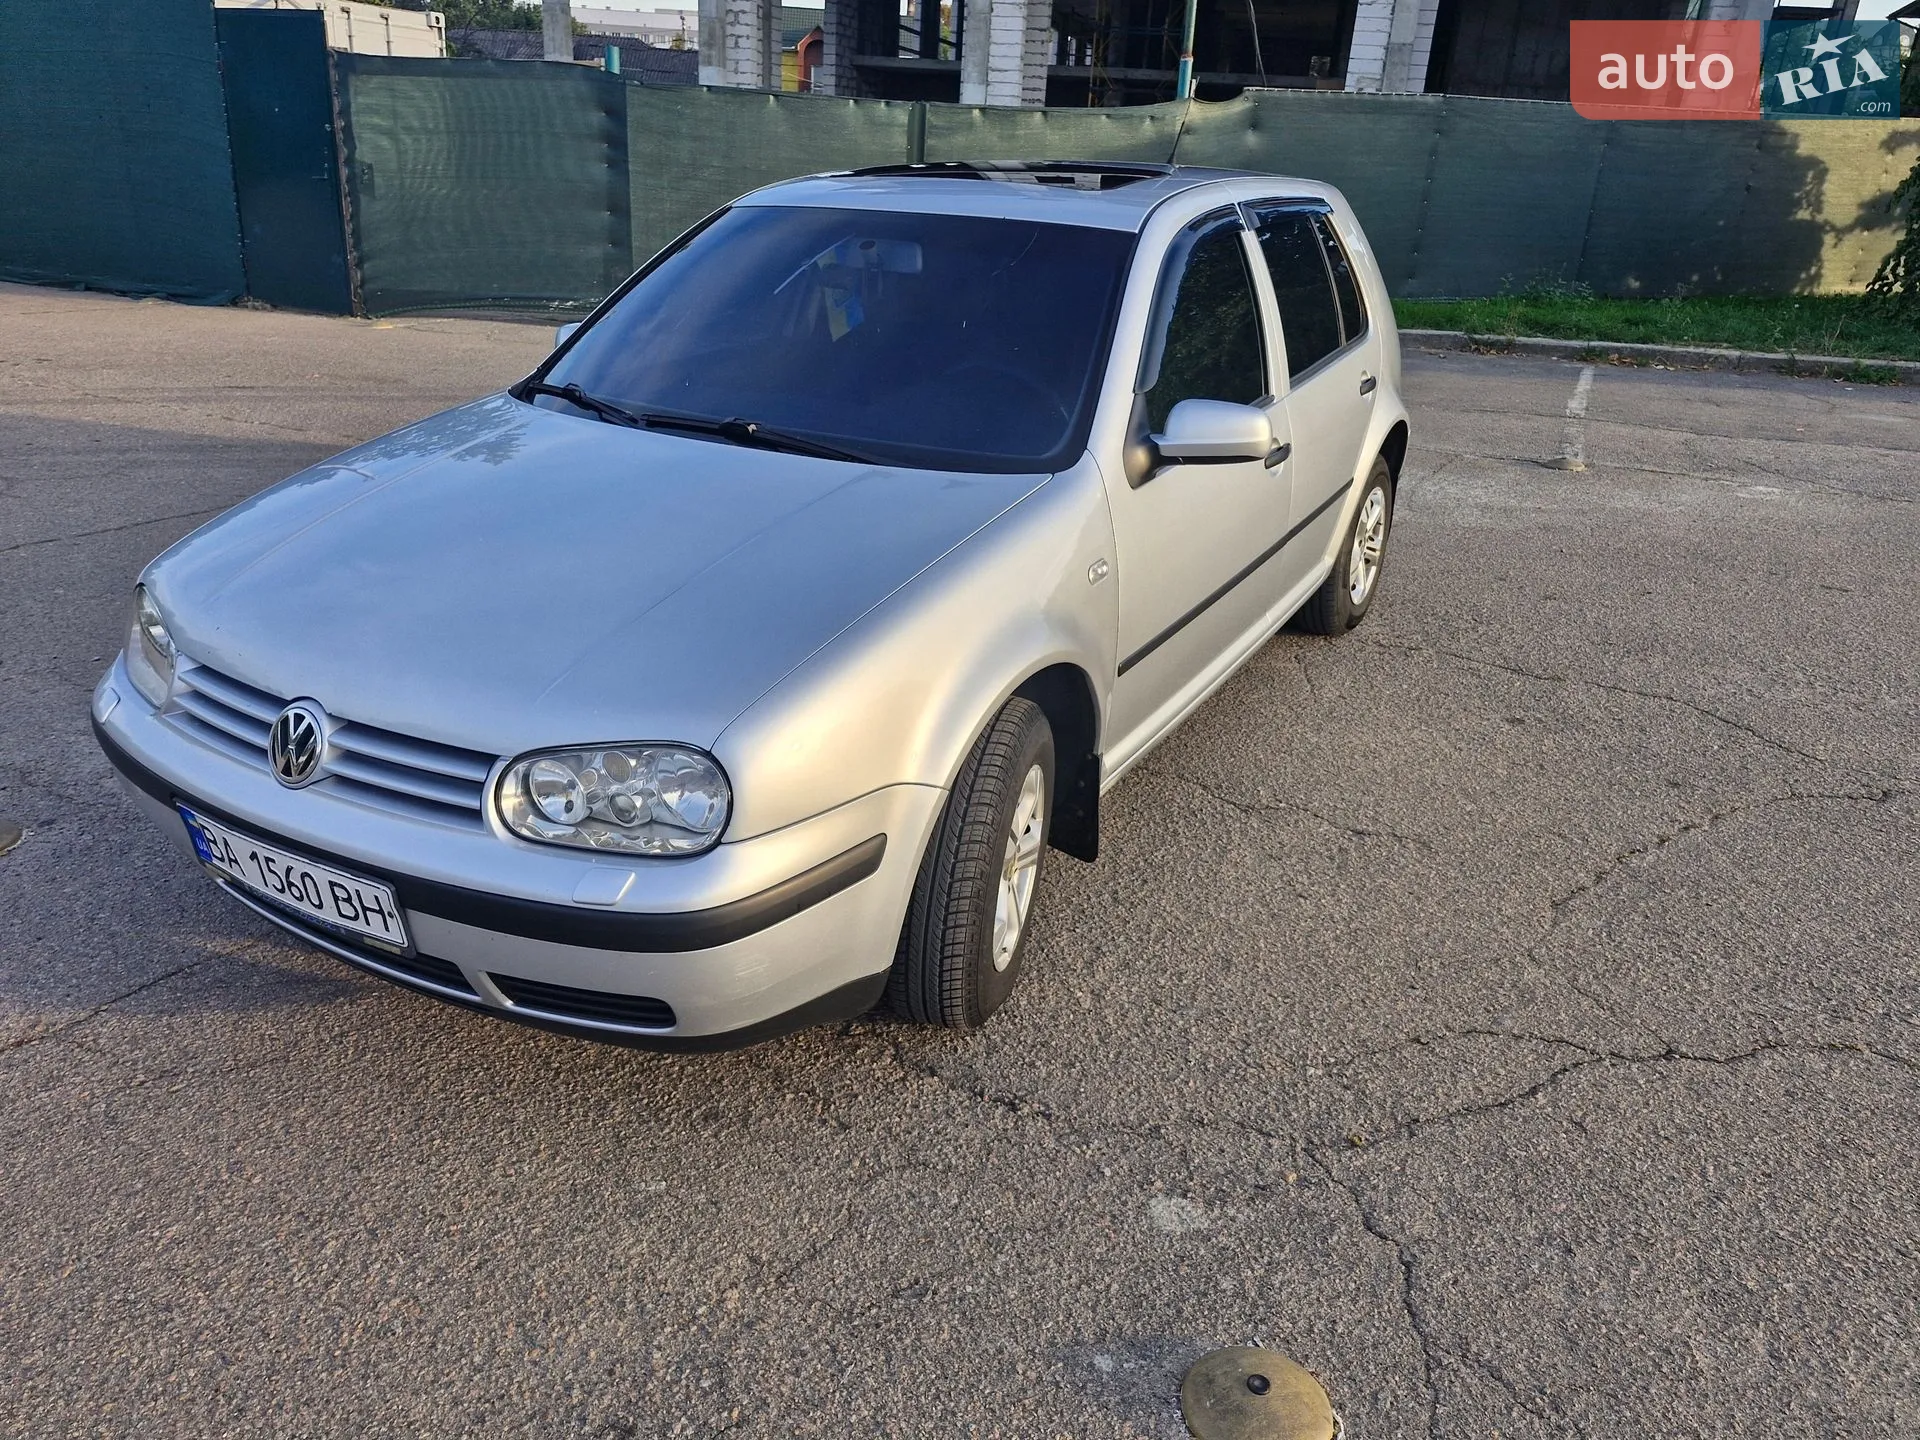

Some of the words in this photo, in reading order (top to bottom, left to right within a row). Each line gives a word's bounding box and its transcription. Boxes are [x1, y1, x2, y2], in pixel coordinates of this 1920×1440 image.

[199, 823, 247, 877] BA
[249, 851, 323, 910] 1560
[328, 880, 391, 933] BH
